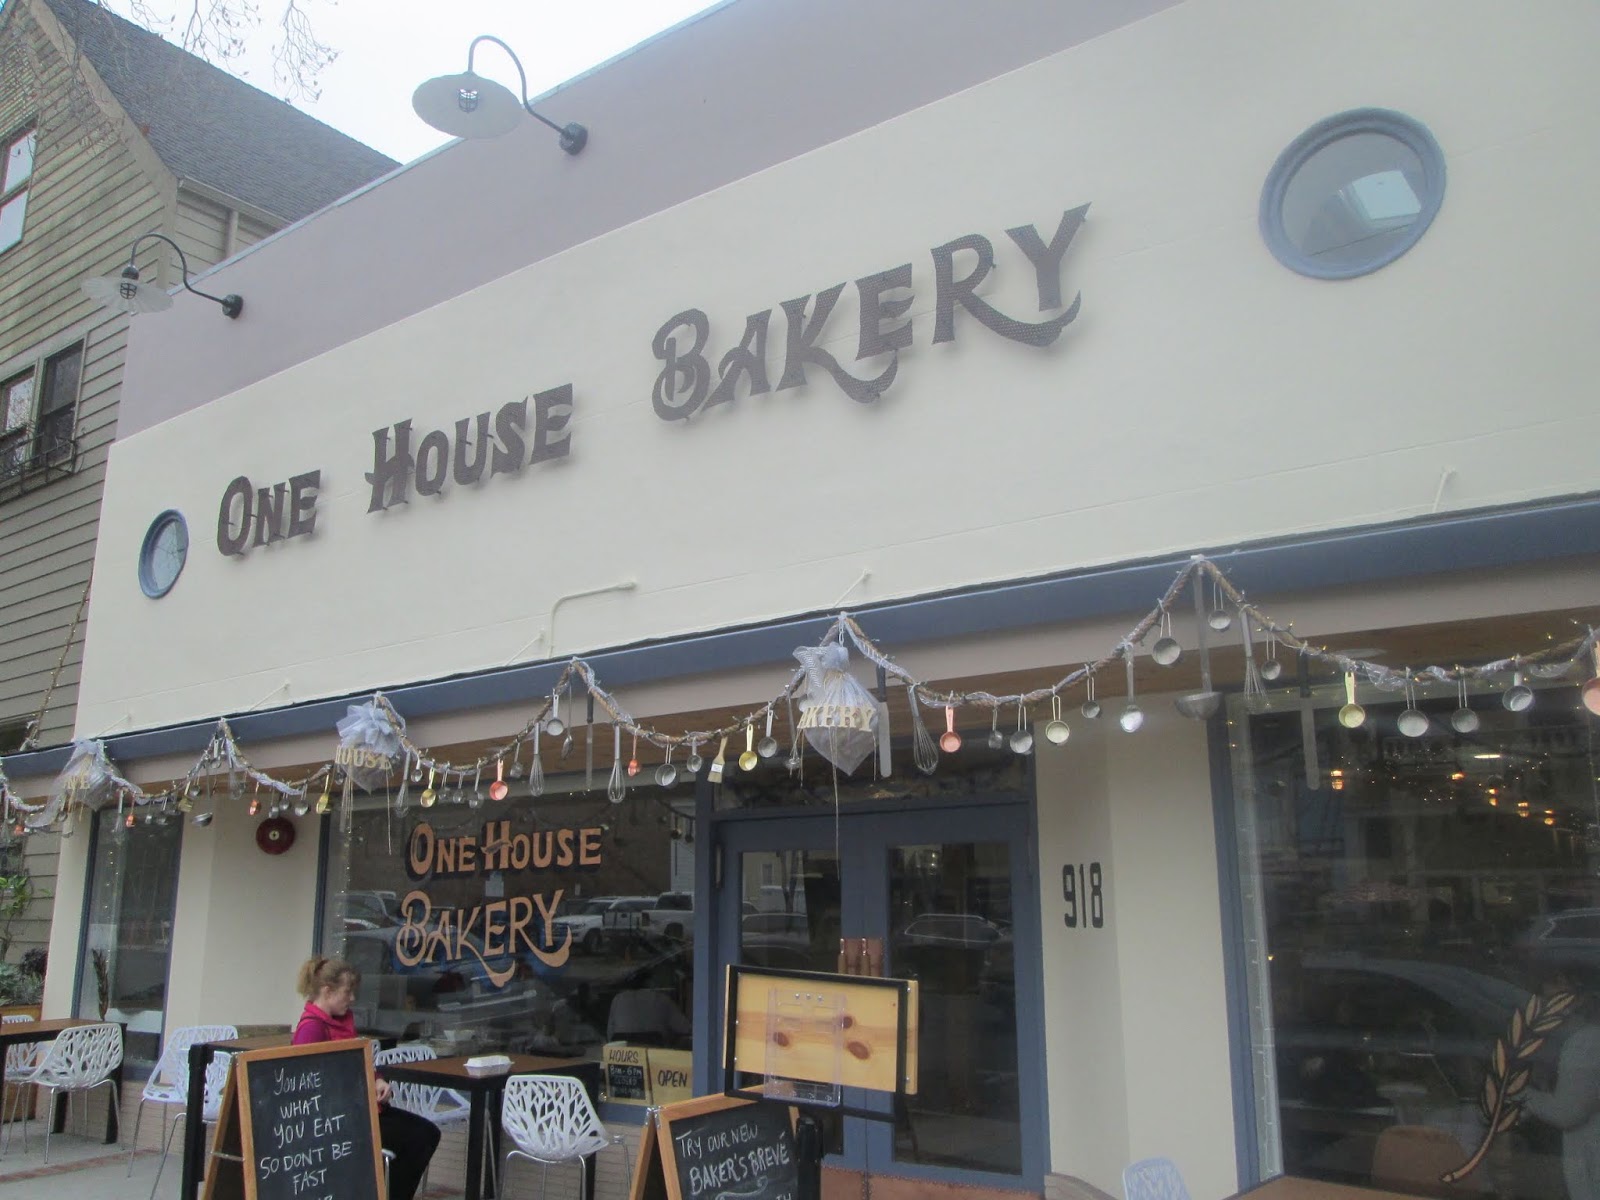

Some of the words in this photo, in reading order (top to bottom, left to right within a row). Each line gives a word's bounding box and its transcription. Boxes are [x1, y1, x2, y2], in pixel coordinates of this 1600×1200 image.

[217, 469, 322, 557] ONE
[364, 383, 573, 514] HOUSE
[651, 202, 1092, 421] BAKERY
[409, 822, 476, 876] ONE
[480, 820, 602, 871] HOUSE
[1062, 862, 1104, 929] 918
[395, 889, 573, 988] BAKERY
[609, 1049, 639, 1064] HOURS
[273, 1067, 296, 1096] YOU
[299, 1071, 322, 1090] ARE
[657, 1069, 688, 1088] OPEN
[279, 1094, 322, 1119] WHAT
[273, 1120, 305, 1149] YOU
[313, 1114, 345, 1138] EAT
[675, 1129, 702, 1160] TRY
[707, 1131, 731, 1152] OUR
[730, 1122, 758, 1143] NEW
[260, 1156, 280, 1180] SO
[331, 1141, 353, 1161] BE
[689, 1152, 748, 1195] BAKER'S
[293, 1168, 328, 1196] FAST
